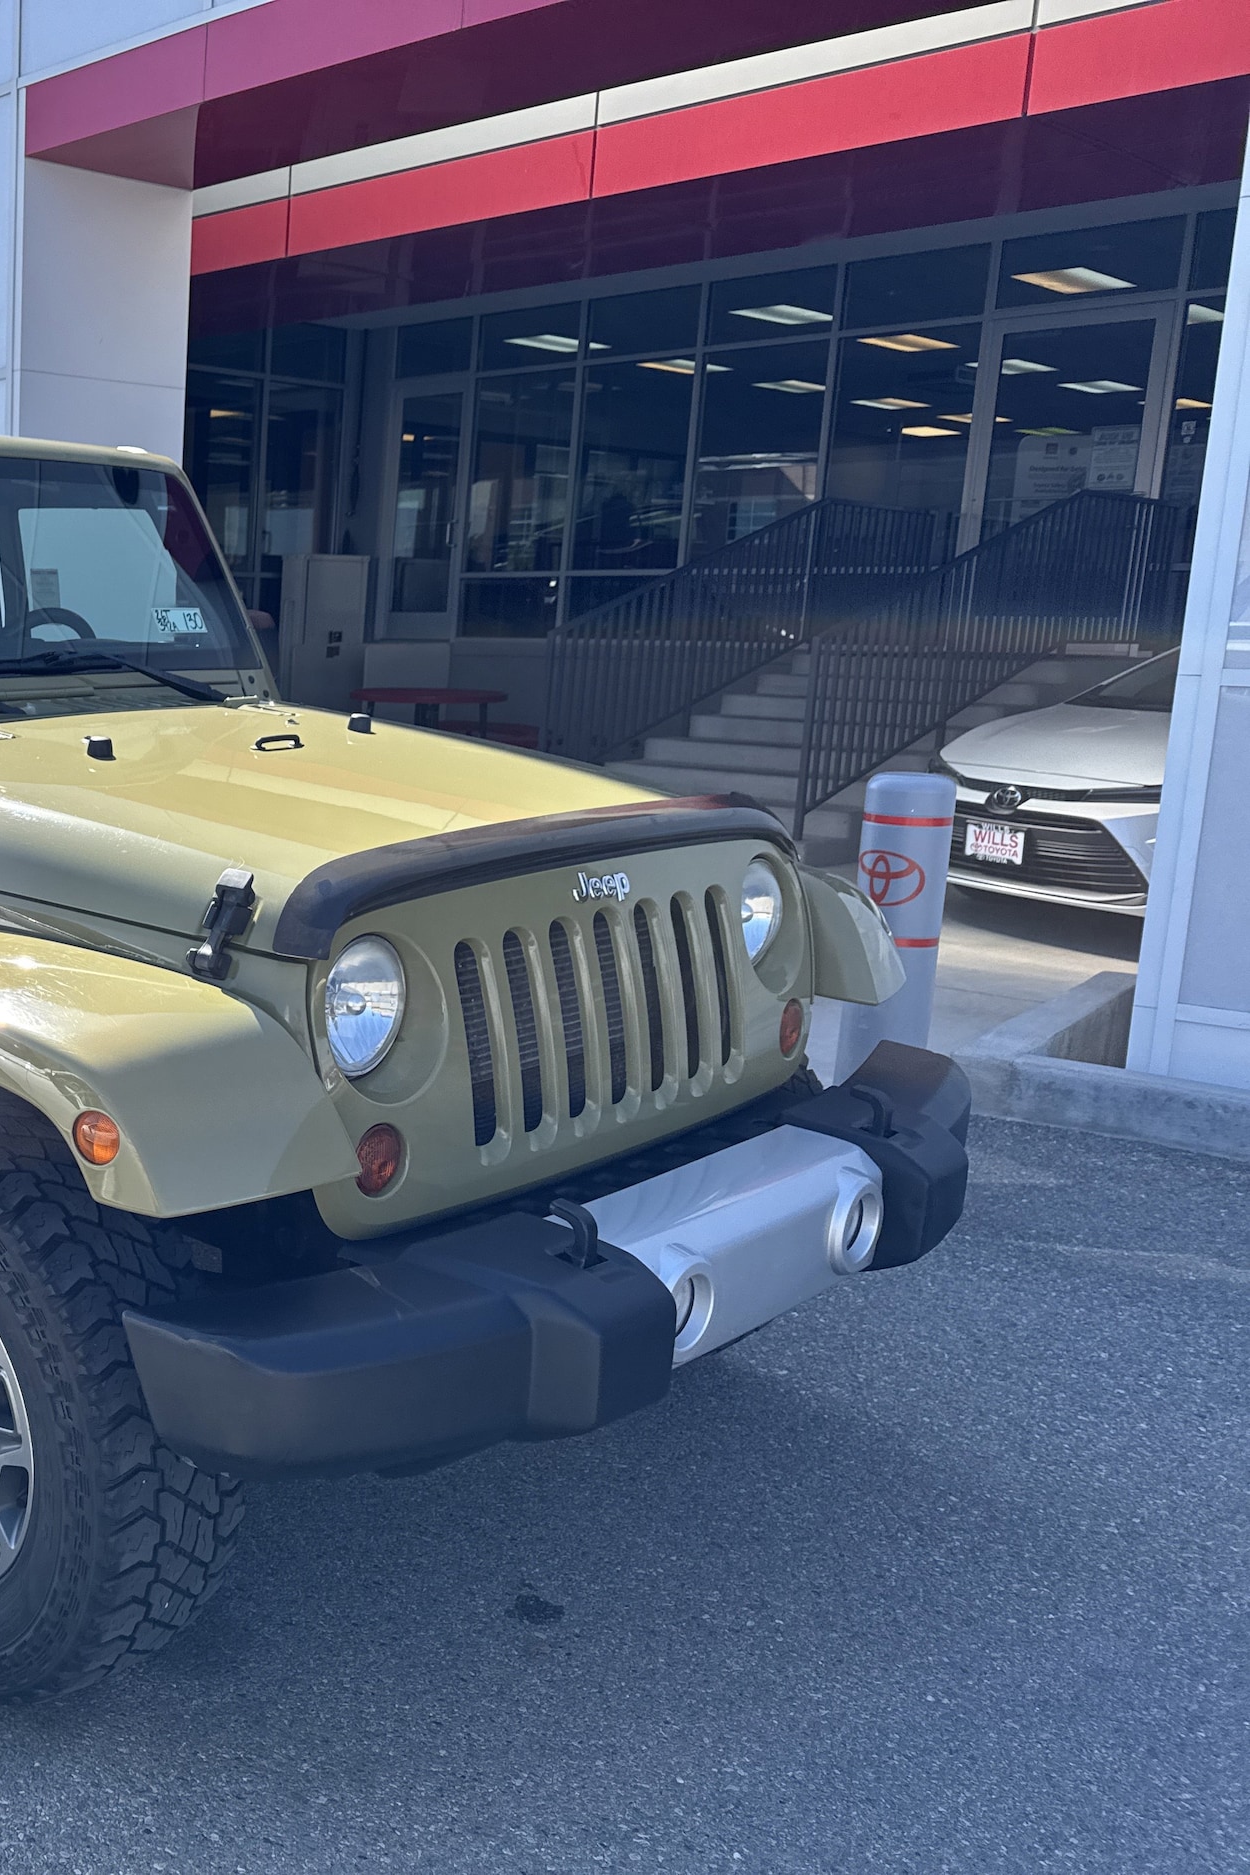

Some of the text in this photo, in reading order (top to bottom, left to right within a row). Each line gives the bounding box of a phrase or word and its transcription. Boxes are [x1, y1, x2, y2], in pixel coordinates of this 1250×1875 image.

[183, 611, 204, 631] 130
[973, 829, 1019, 849] WILLS
[983, 845, 1019, 858] TOYOTA
[572, 872, 631, 903] Jeep
